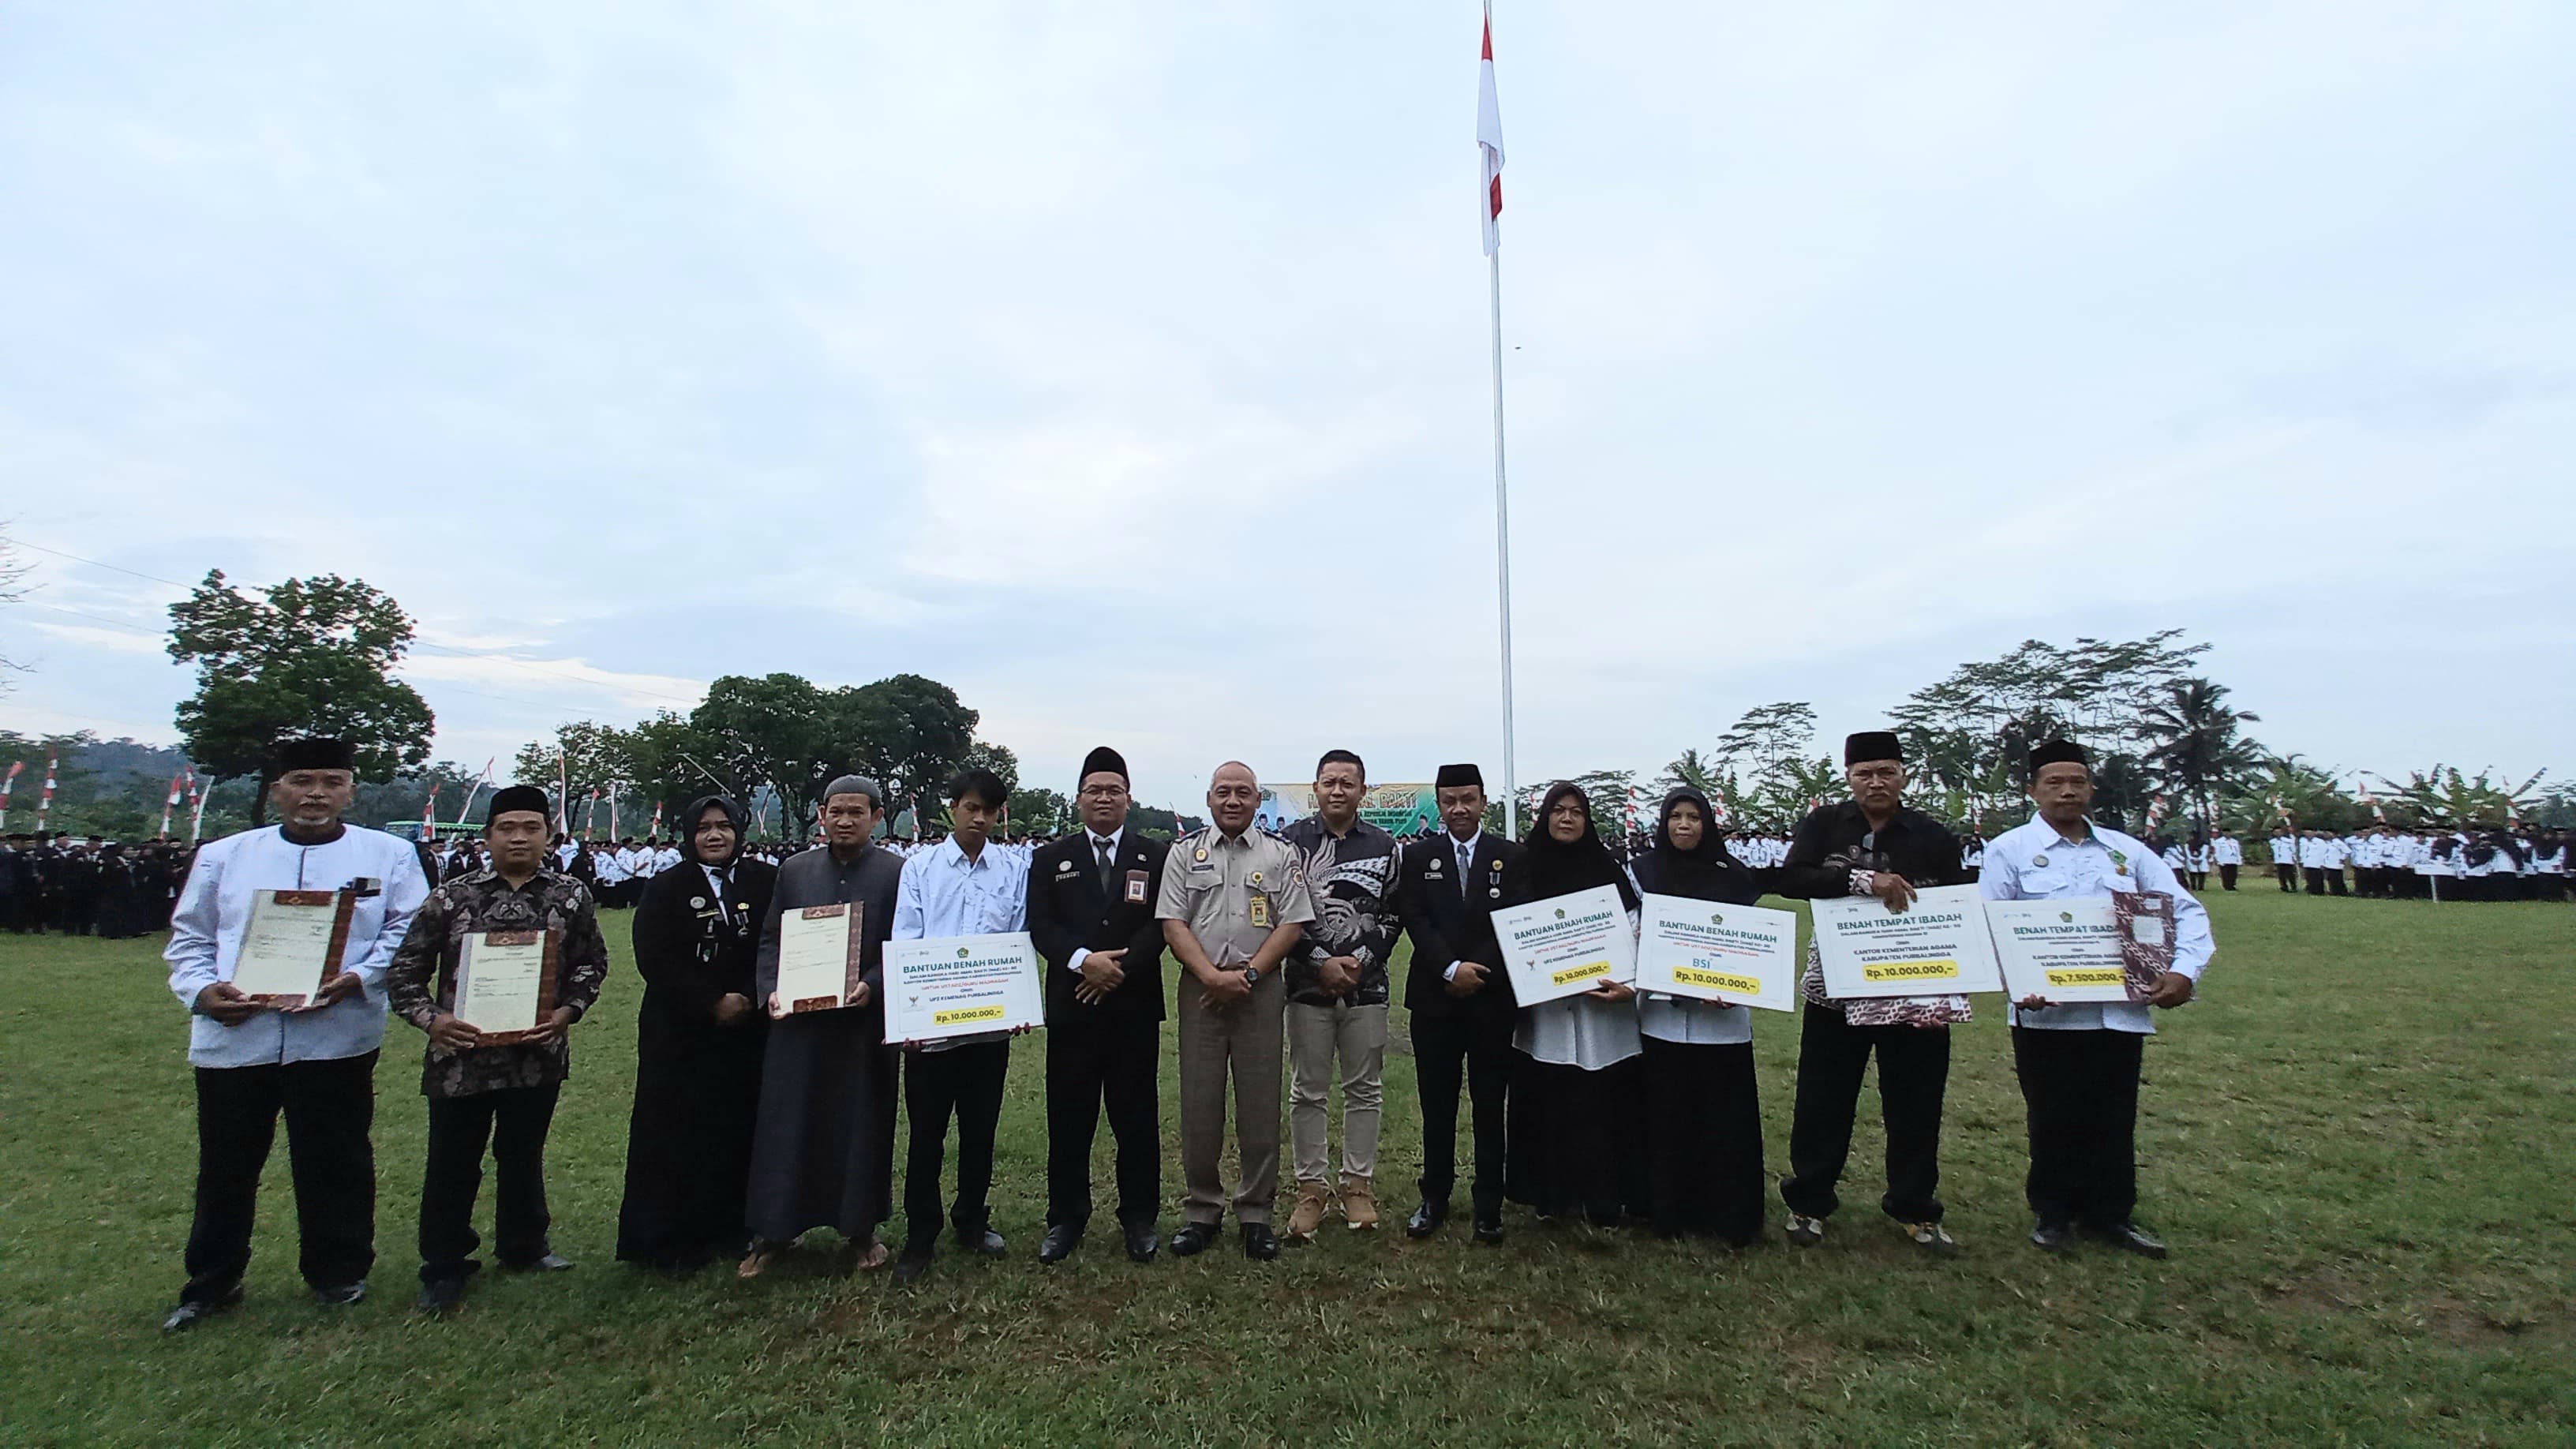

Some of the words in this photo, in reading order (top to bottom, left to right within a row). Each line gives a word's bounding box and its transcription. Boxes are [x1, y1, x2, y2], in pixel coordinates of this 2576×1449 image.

[1380, 792, 1417, 808] BAKTI
[1515, 924, 1554, 940] BANTUAN
[1554, 918, 1582, 930] BENAH
[1583, 911, 1614, 923] RUMAH
[1837, 921, 1873, 930] BENAH
[1874, 916, 1916, 927] TEMPAT
[1919, 913, 1963, 924] IBADAH
[1659, 920, 1705, 933] BANTUAN
[1706, 927, 1739, 938] BENAH
[1740, 931, 1777, 942] RUMAH
[2048, 925, 2087, 934] TEMPAT
[903, 962, 951, 973] BANTUAN
[953, 959, 986, 969] BENAH
[987, 957, 1022, 966] RUMAH
[1693, 958, 1710, 969] BSI
[1676, 971, 1691, 982] Rp.
[1866, 969, 1884, 979] Rp.
[1884, 965, 1953, 976] 10.000.000,-
[1553, 975, 1566, 985] Rp.
[951, 1009, 1001, 1020] 10.000.000,-
